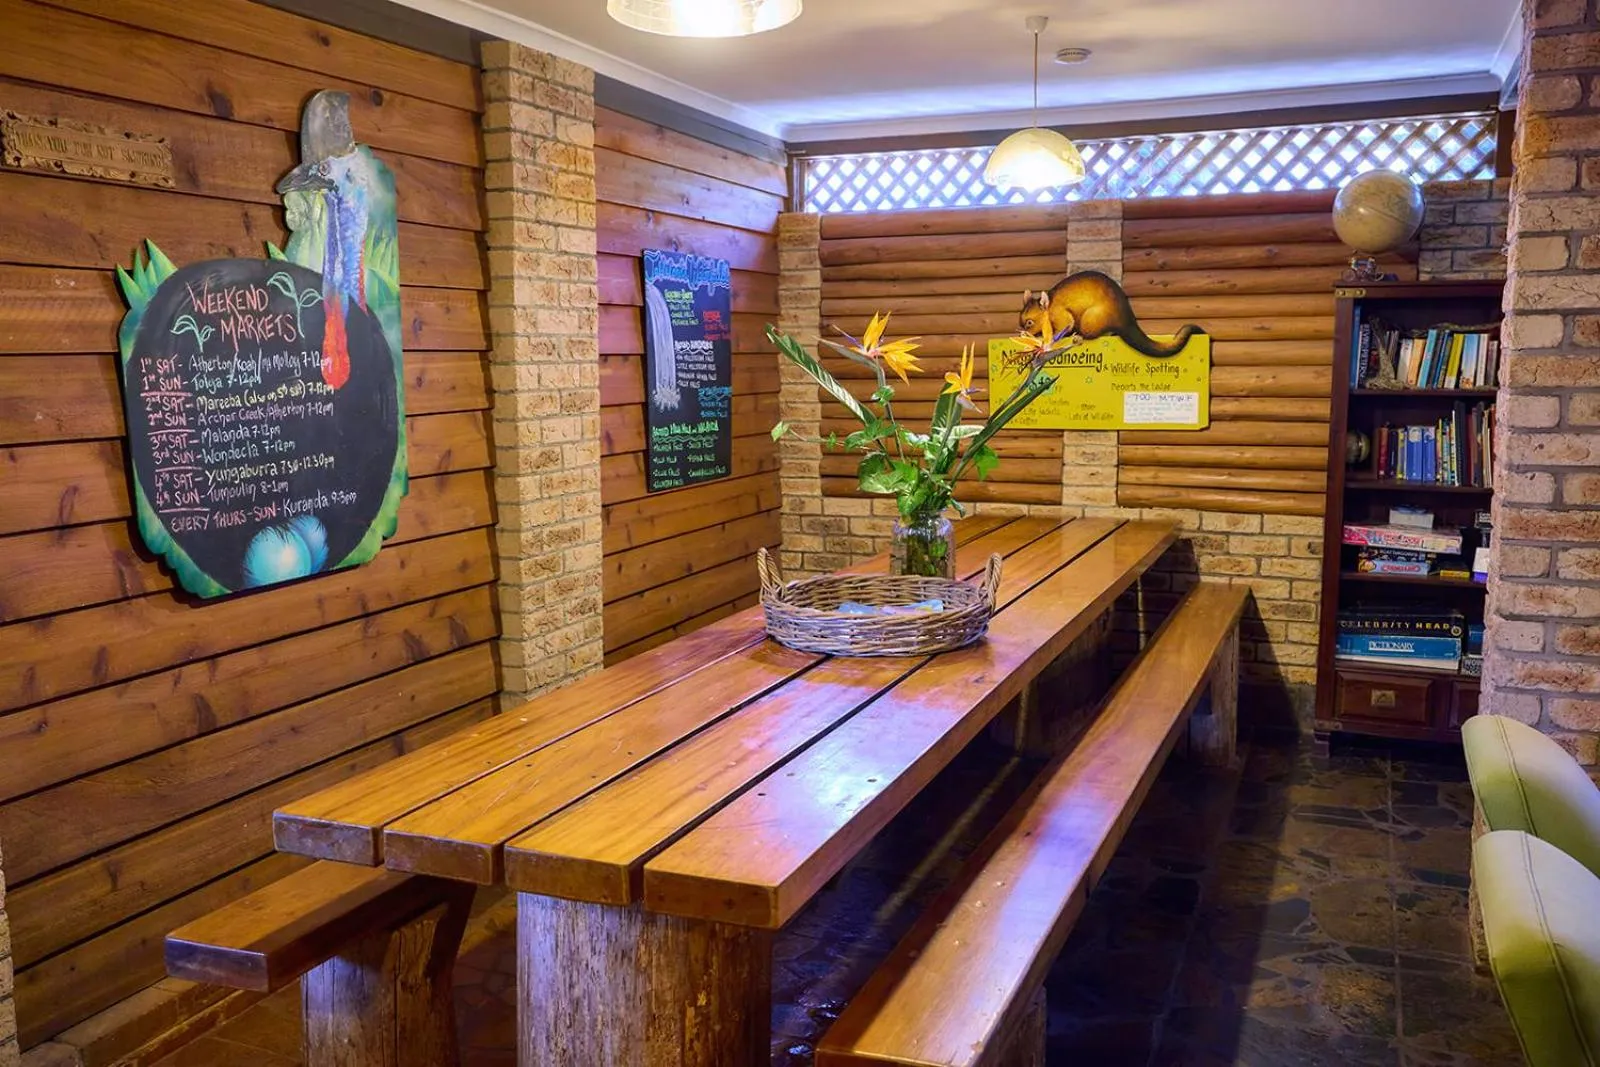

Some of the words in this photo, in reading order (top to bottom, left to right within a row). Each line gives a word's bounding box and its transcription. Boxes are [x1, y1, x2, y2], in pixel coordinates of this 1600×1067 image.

[186, 281, 269, 315] WEEKEND
[221, 313, 297, 347] MARKETS
[1111, 362, 1140, 374] Wildlife
[1145, 362, 1180, 379] Spotting
[196, 394, 241, 414] Mareeba
[202, 424, 251, 447] Malanda
[202, 441, 259, 466] Wondecla
[205, 462, 278, 485] Yungaburra
[207, 482, 256, 505] Tumoulin
[171, 514, 209, 533] EVERY
[283, 489, 328, 517] Kuranda
[1369, 641, 1414, 650] PICTIONARY
